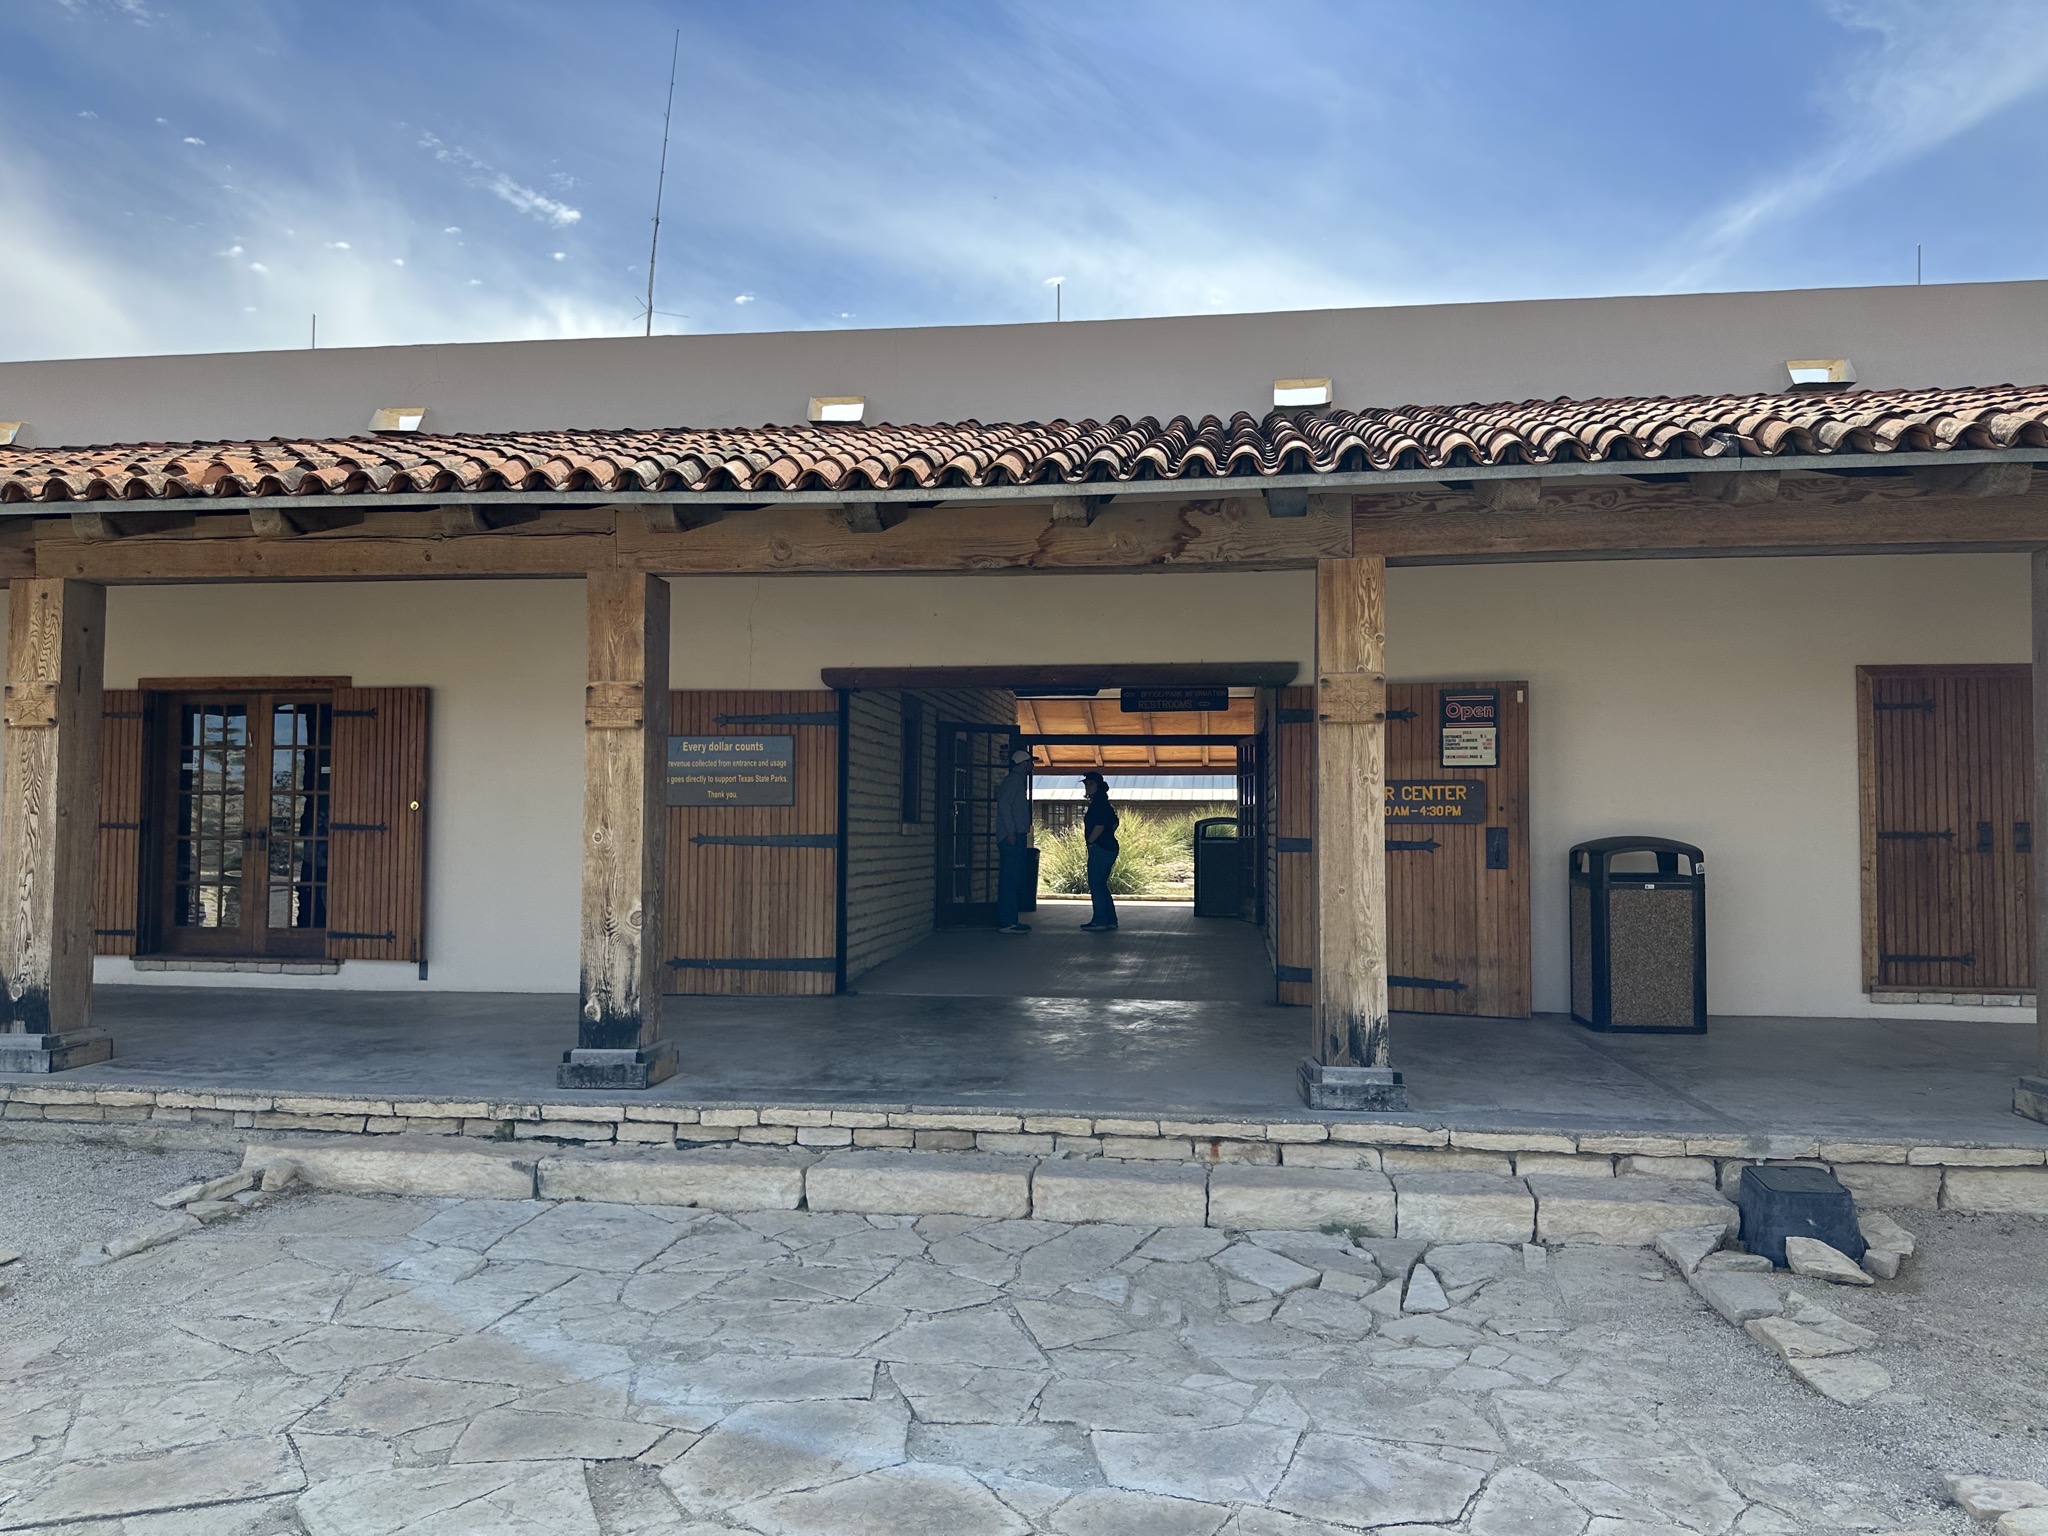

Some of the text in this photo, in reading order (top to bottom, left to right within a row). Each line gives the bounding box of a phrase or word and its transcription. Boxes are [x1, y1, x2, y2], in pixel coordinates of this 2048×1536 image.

[1138, 700, 1192, 709] RESTROOMS
[1446, 703, 1494, 720] Open
[682, 741, 764, 753] Every dollar counts
[692, 759, 717, 767] collected
[718, 759, 731, 767] from
[758, 759, 769, 767] and
[770, 760, 787, 768] usage
[671, 776, 684, 784] goes
[685, 775, 706, 784] directly
[707, 775, 714, 783] to
[715, 775, 737, 784] support
[738, 774, 754, 783] Texas
[755, 774, 769, 783] State
[707, 790, 738, 800] Thank you.
[1401, 785, 1467, 801] CENTER
